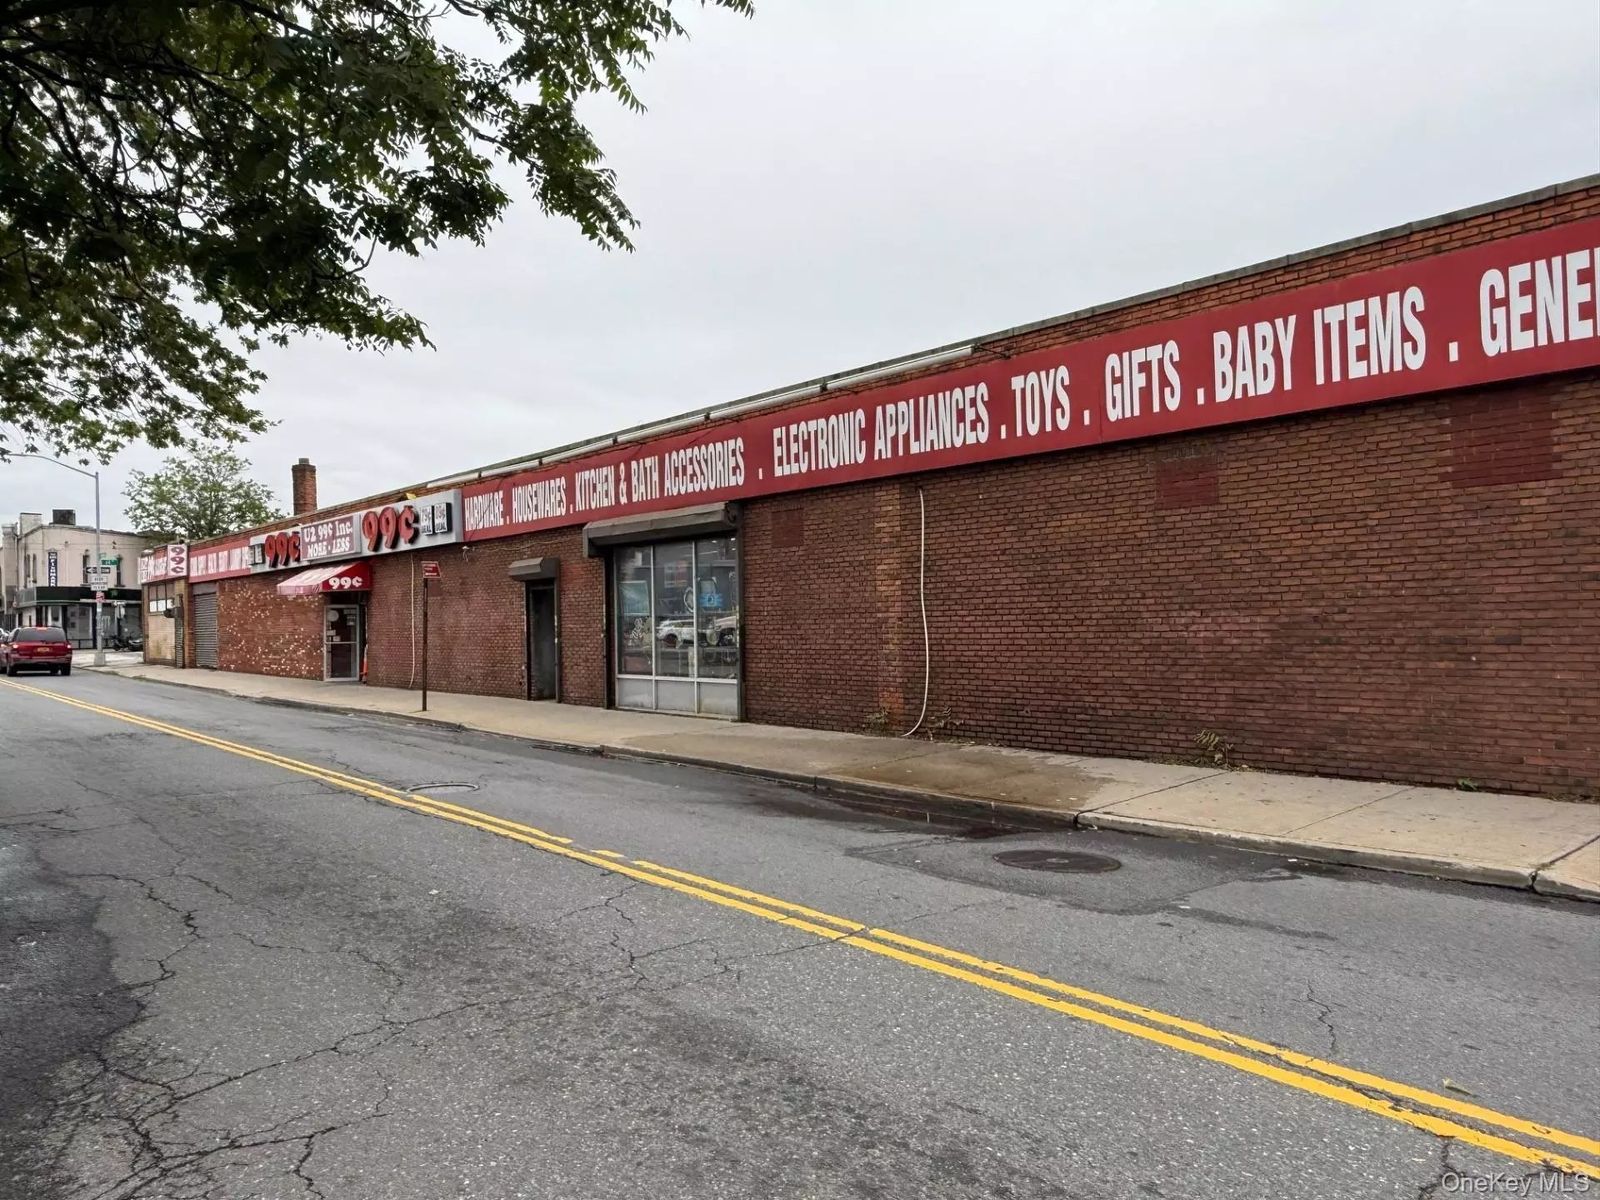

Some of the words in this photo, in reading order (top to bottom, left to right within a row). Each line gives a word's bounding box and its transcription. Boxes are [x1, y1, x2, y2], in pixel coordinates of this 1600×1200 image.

[464, 490, 504, 531] HARDWARE
[512, 477, 566, 523] HOUSEWARES
[576, 465, 615, 511] KITCHEN
[619, 463, 628, 504] &
[631, 455, 659, 502] BATH
[664, 437, 744, 496] ACCESSORIES
[772, 409, 867, 477] ELECTRONIC
[874, 381, 989, 460] APPLIANCES
[1010, 366, 1070, 436] TOYS
[1104, 340, 1180, 422] GIFTS
[1213, 315, 1297, 403] BABY
[1314, 285, 1427, 386] ITEMS
[303, 527, 316, 542] U2
[318, 523, 333, 540] 99¢
[362, 505, 419, 552] 99¢
[307, 541, 327, 558] MORE
[332, 536, 350, 553] LESS
[328, 576, 362, 589] 99¢
